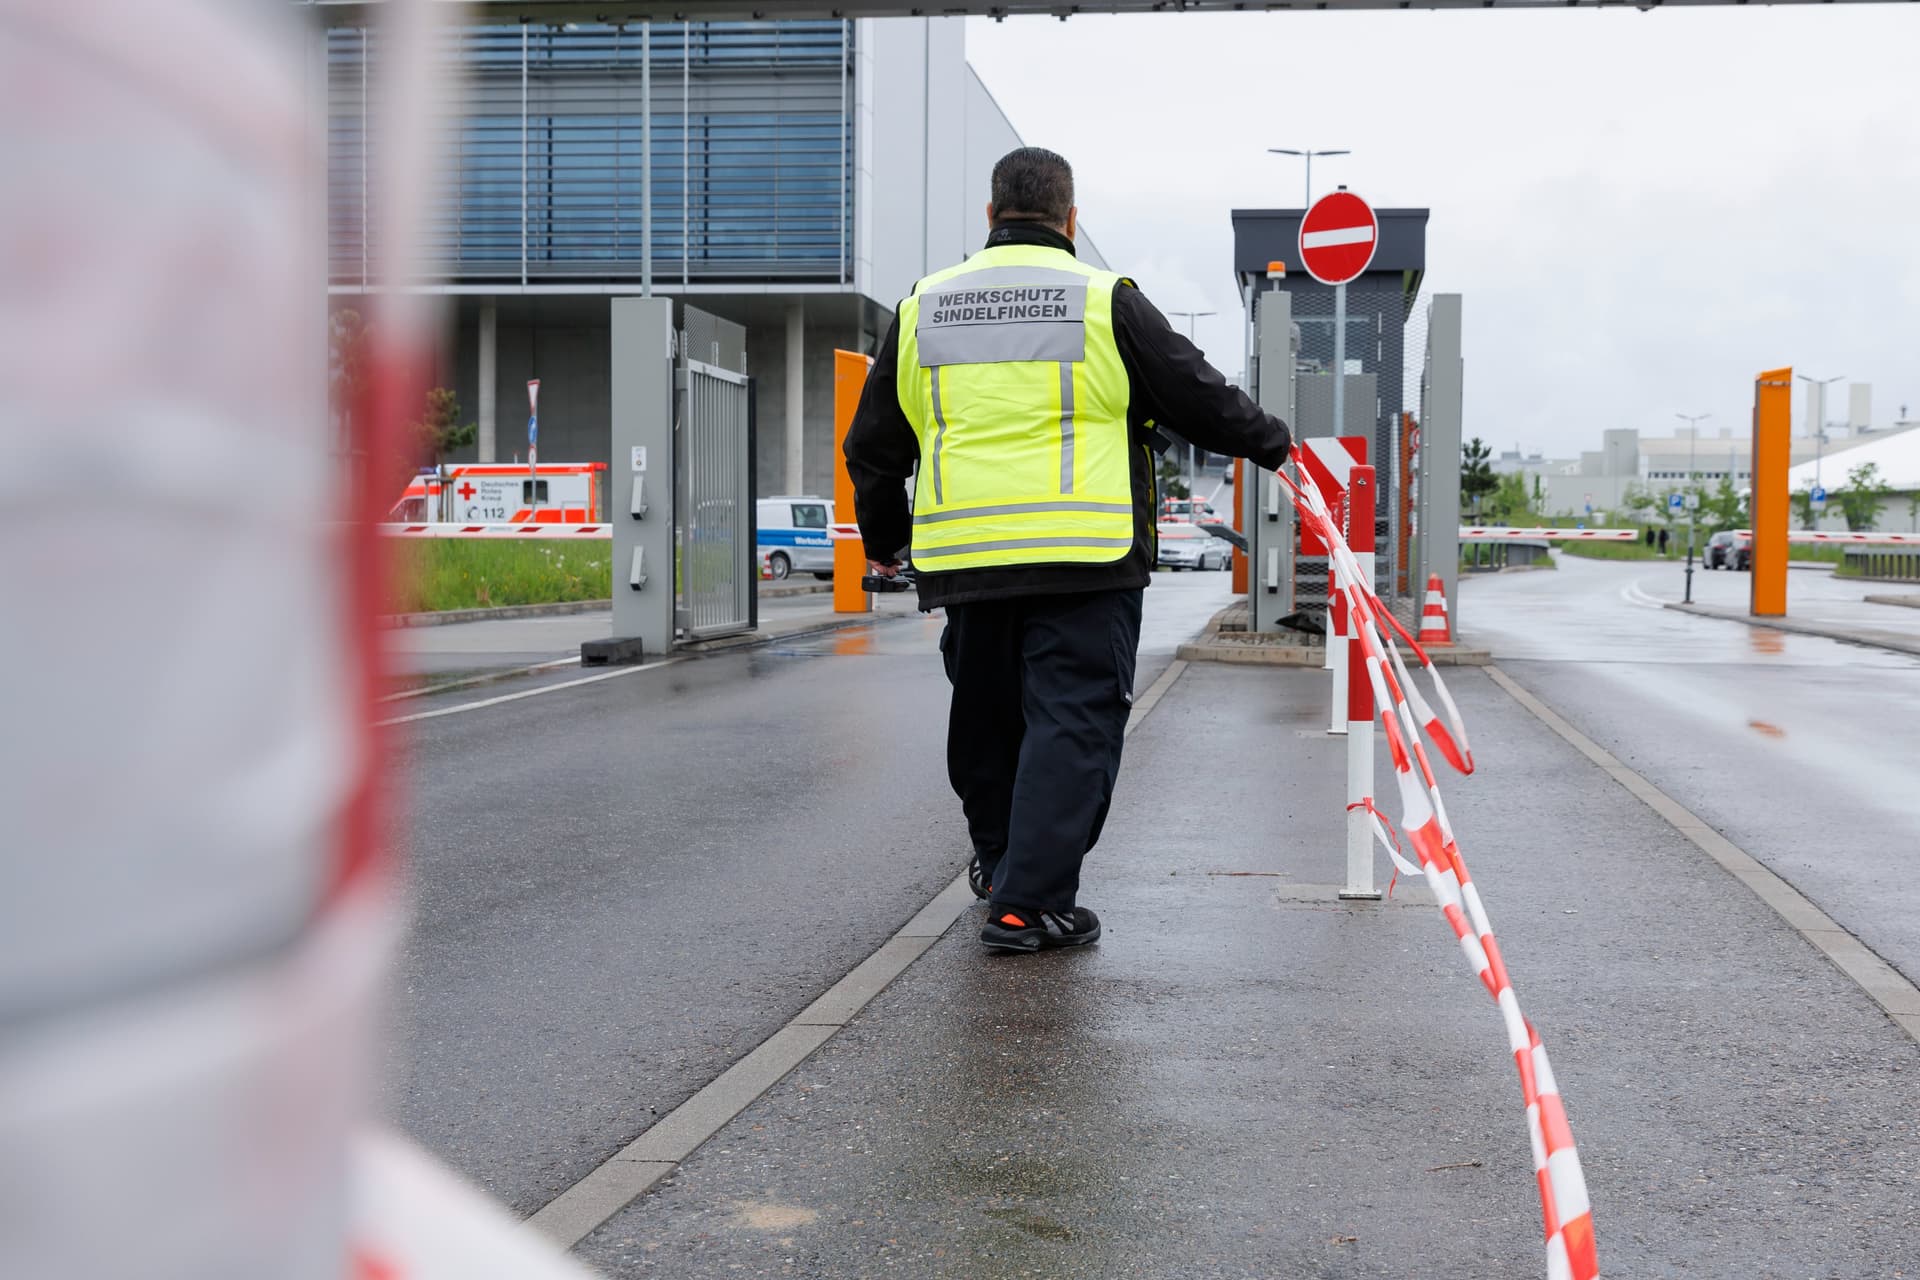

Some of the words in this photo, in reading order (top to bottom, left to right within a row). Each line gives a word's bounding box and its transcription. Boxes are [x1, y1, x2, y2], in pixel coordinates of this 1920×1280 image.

[939, 289, 1066, 307] WERKSCHUTZ
[933, 305, 1068, 323] SINDELFINGEN
[483, 507, 505, 519] 112
[794, 536, 833, 546] Werkschutz
